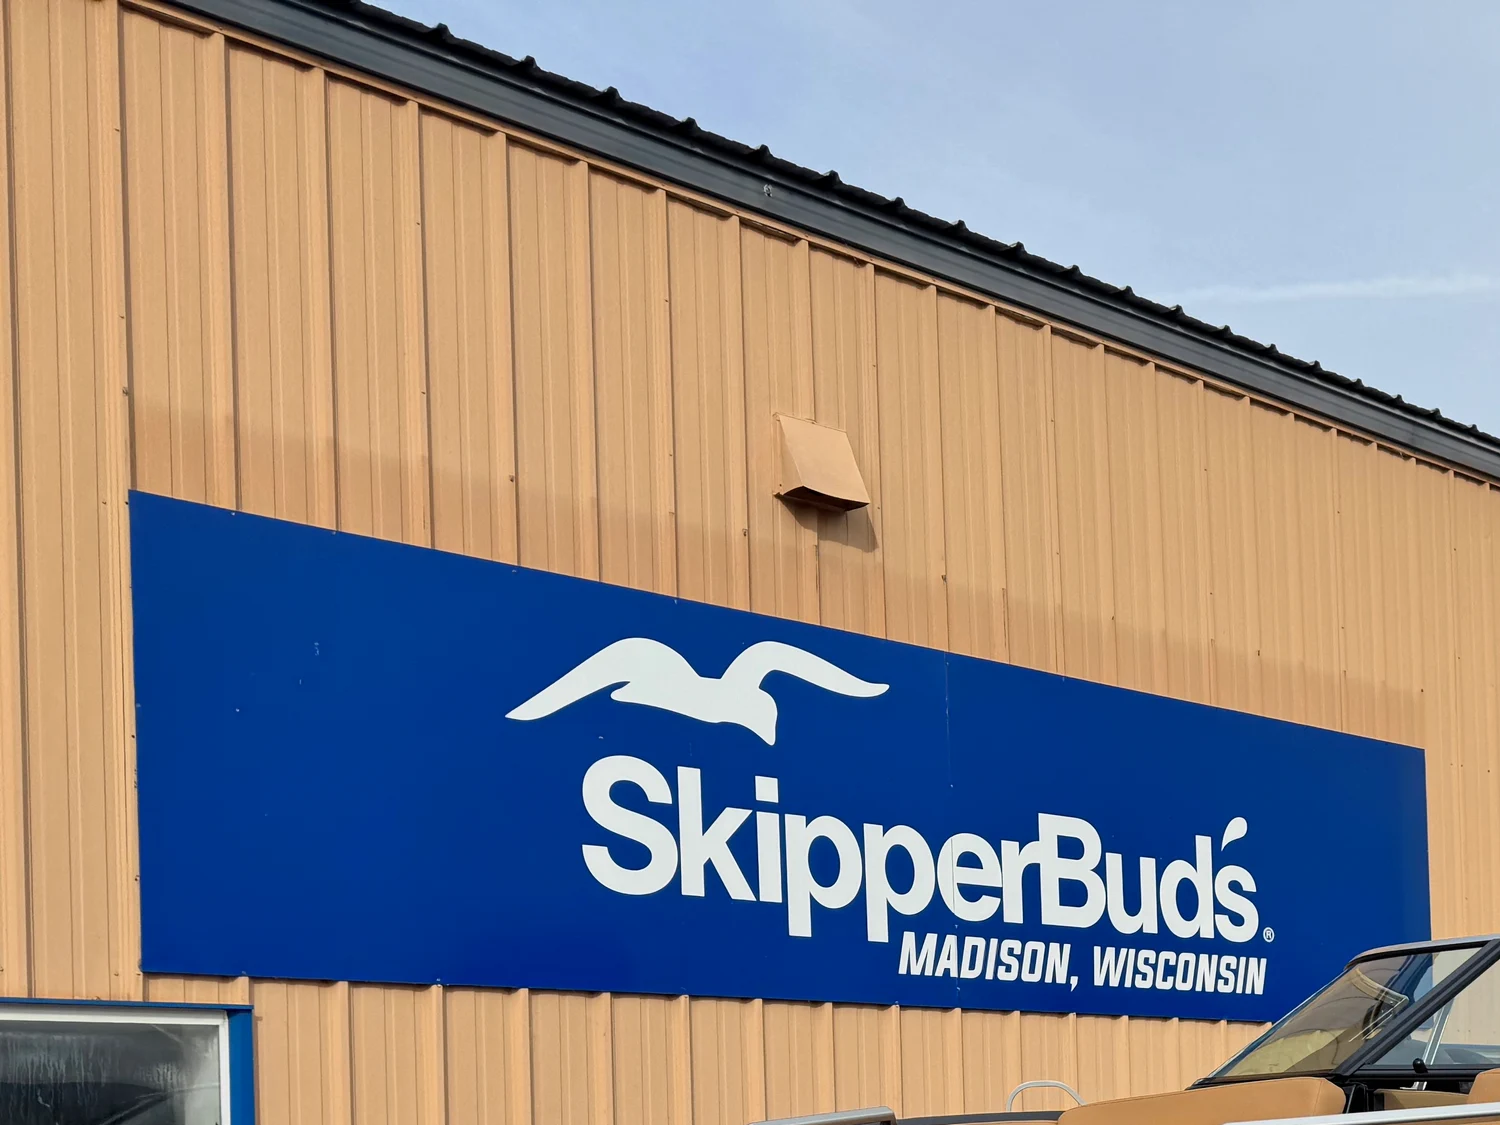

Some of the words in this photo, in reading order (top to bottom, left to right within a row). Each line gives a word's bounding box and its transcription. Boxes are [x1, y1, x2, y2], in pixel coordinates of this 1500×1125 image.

[581, 754, 1262, 943] SkipperBud's
[898, 930, 1079, 992] MADISON,
[1092, 945, 1267, 995] WISCONSIN
